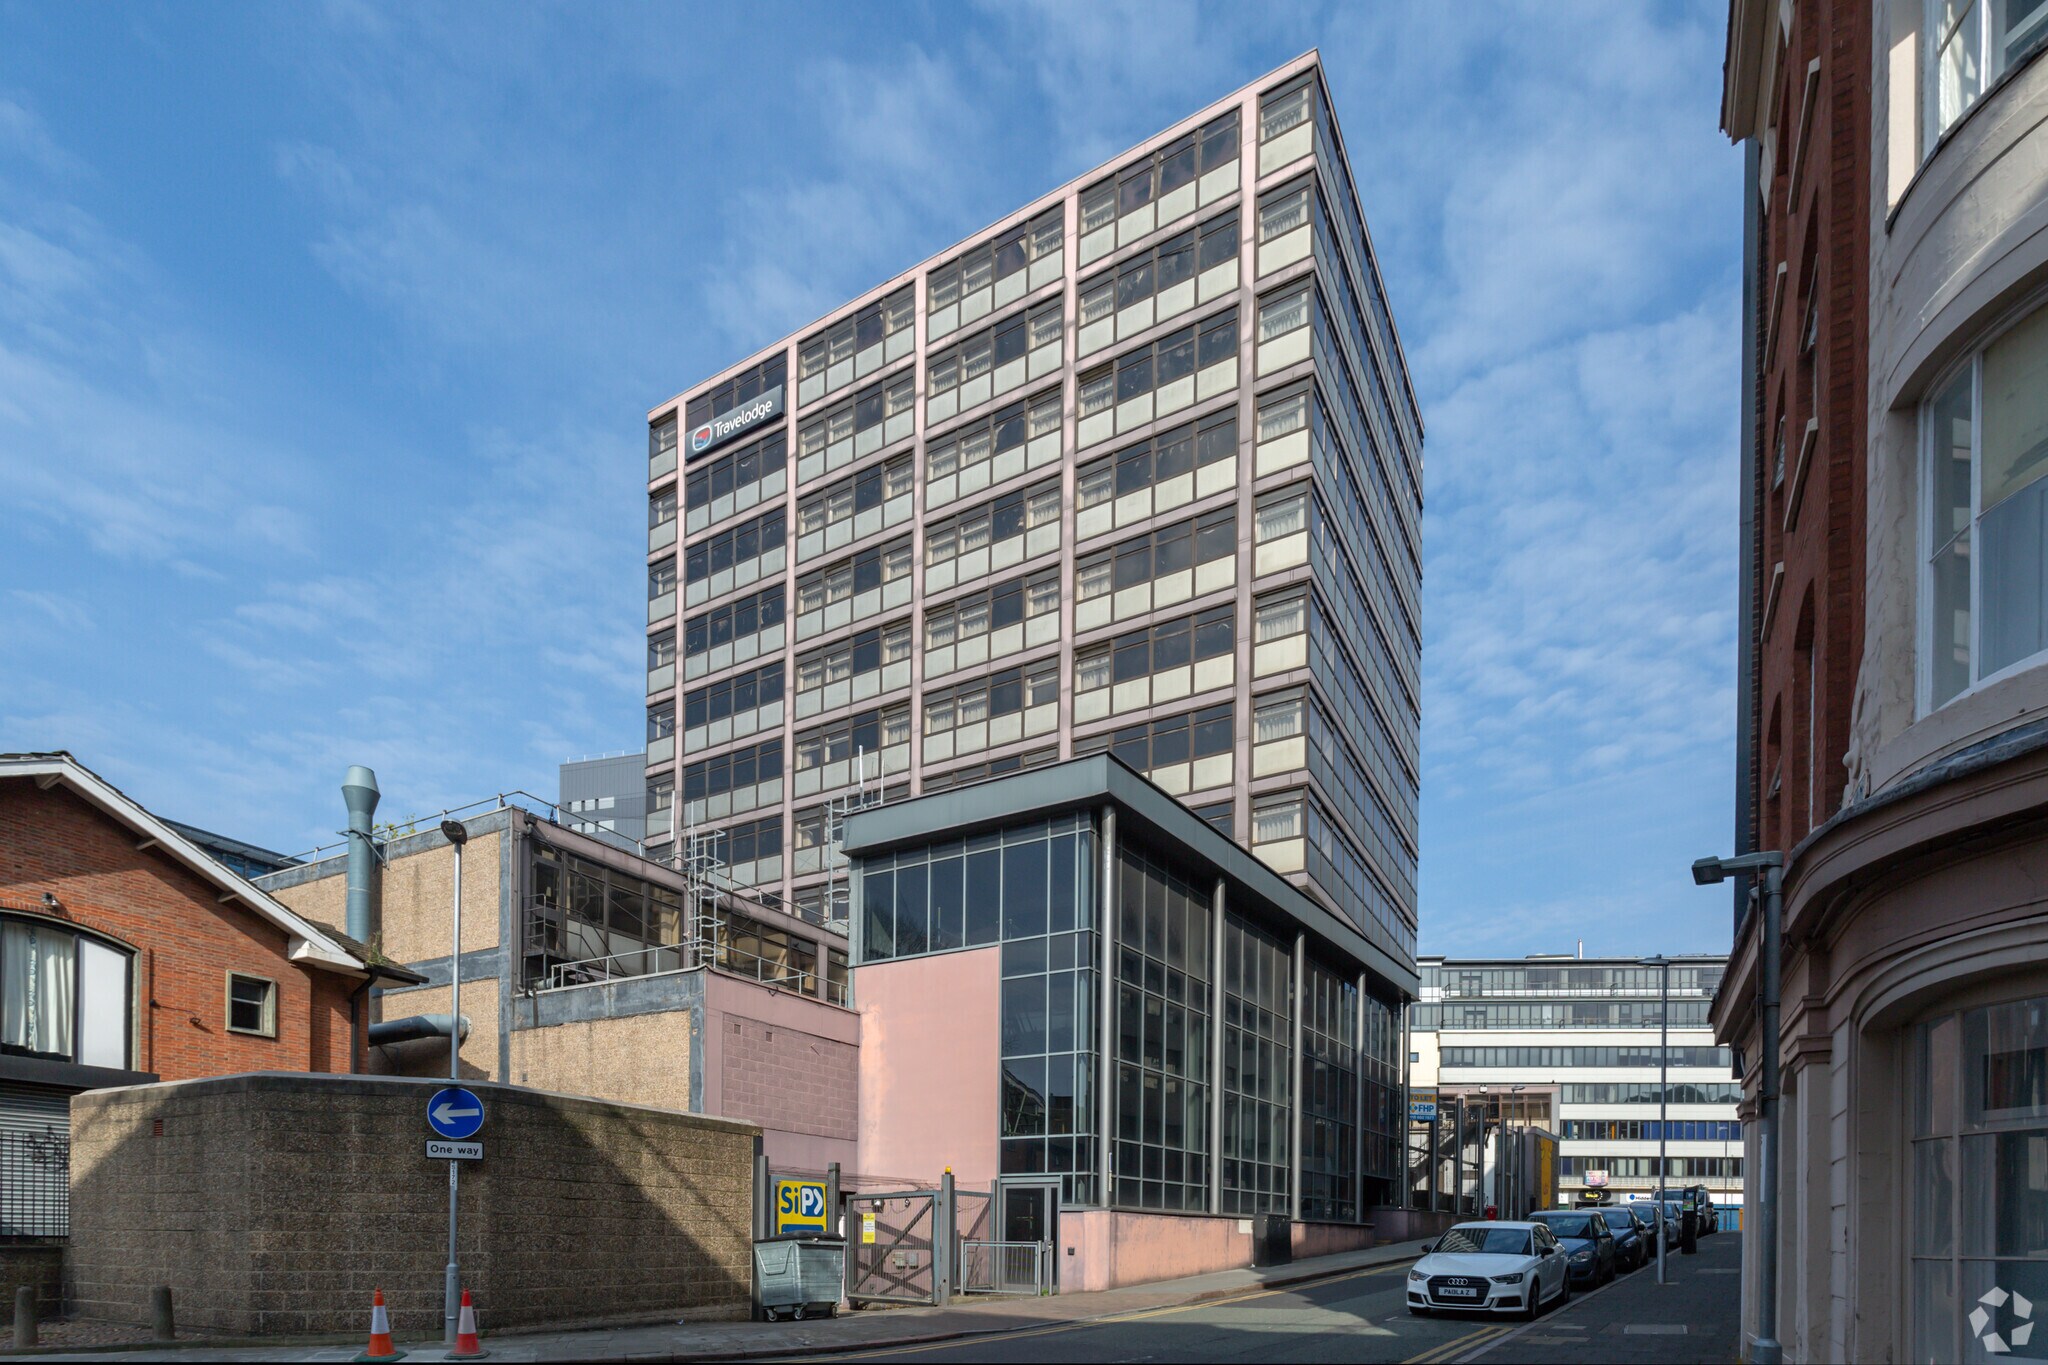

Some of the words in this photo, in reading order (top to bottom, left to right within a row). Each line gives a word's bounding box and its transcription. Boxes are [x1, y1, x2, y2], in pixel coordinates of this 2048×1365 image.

[714, 400, 773, 438] Travelodge
[1418, 1104, 1434, 1112] FHP
[430, 1144, 453, 1154] One
[457, 1147, 479, 1156] way
